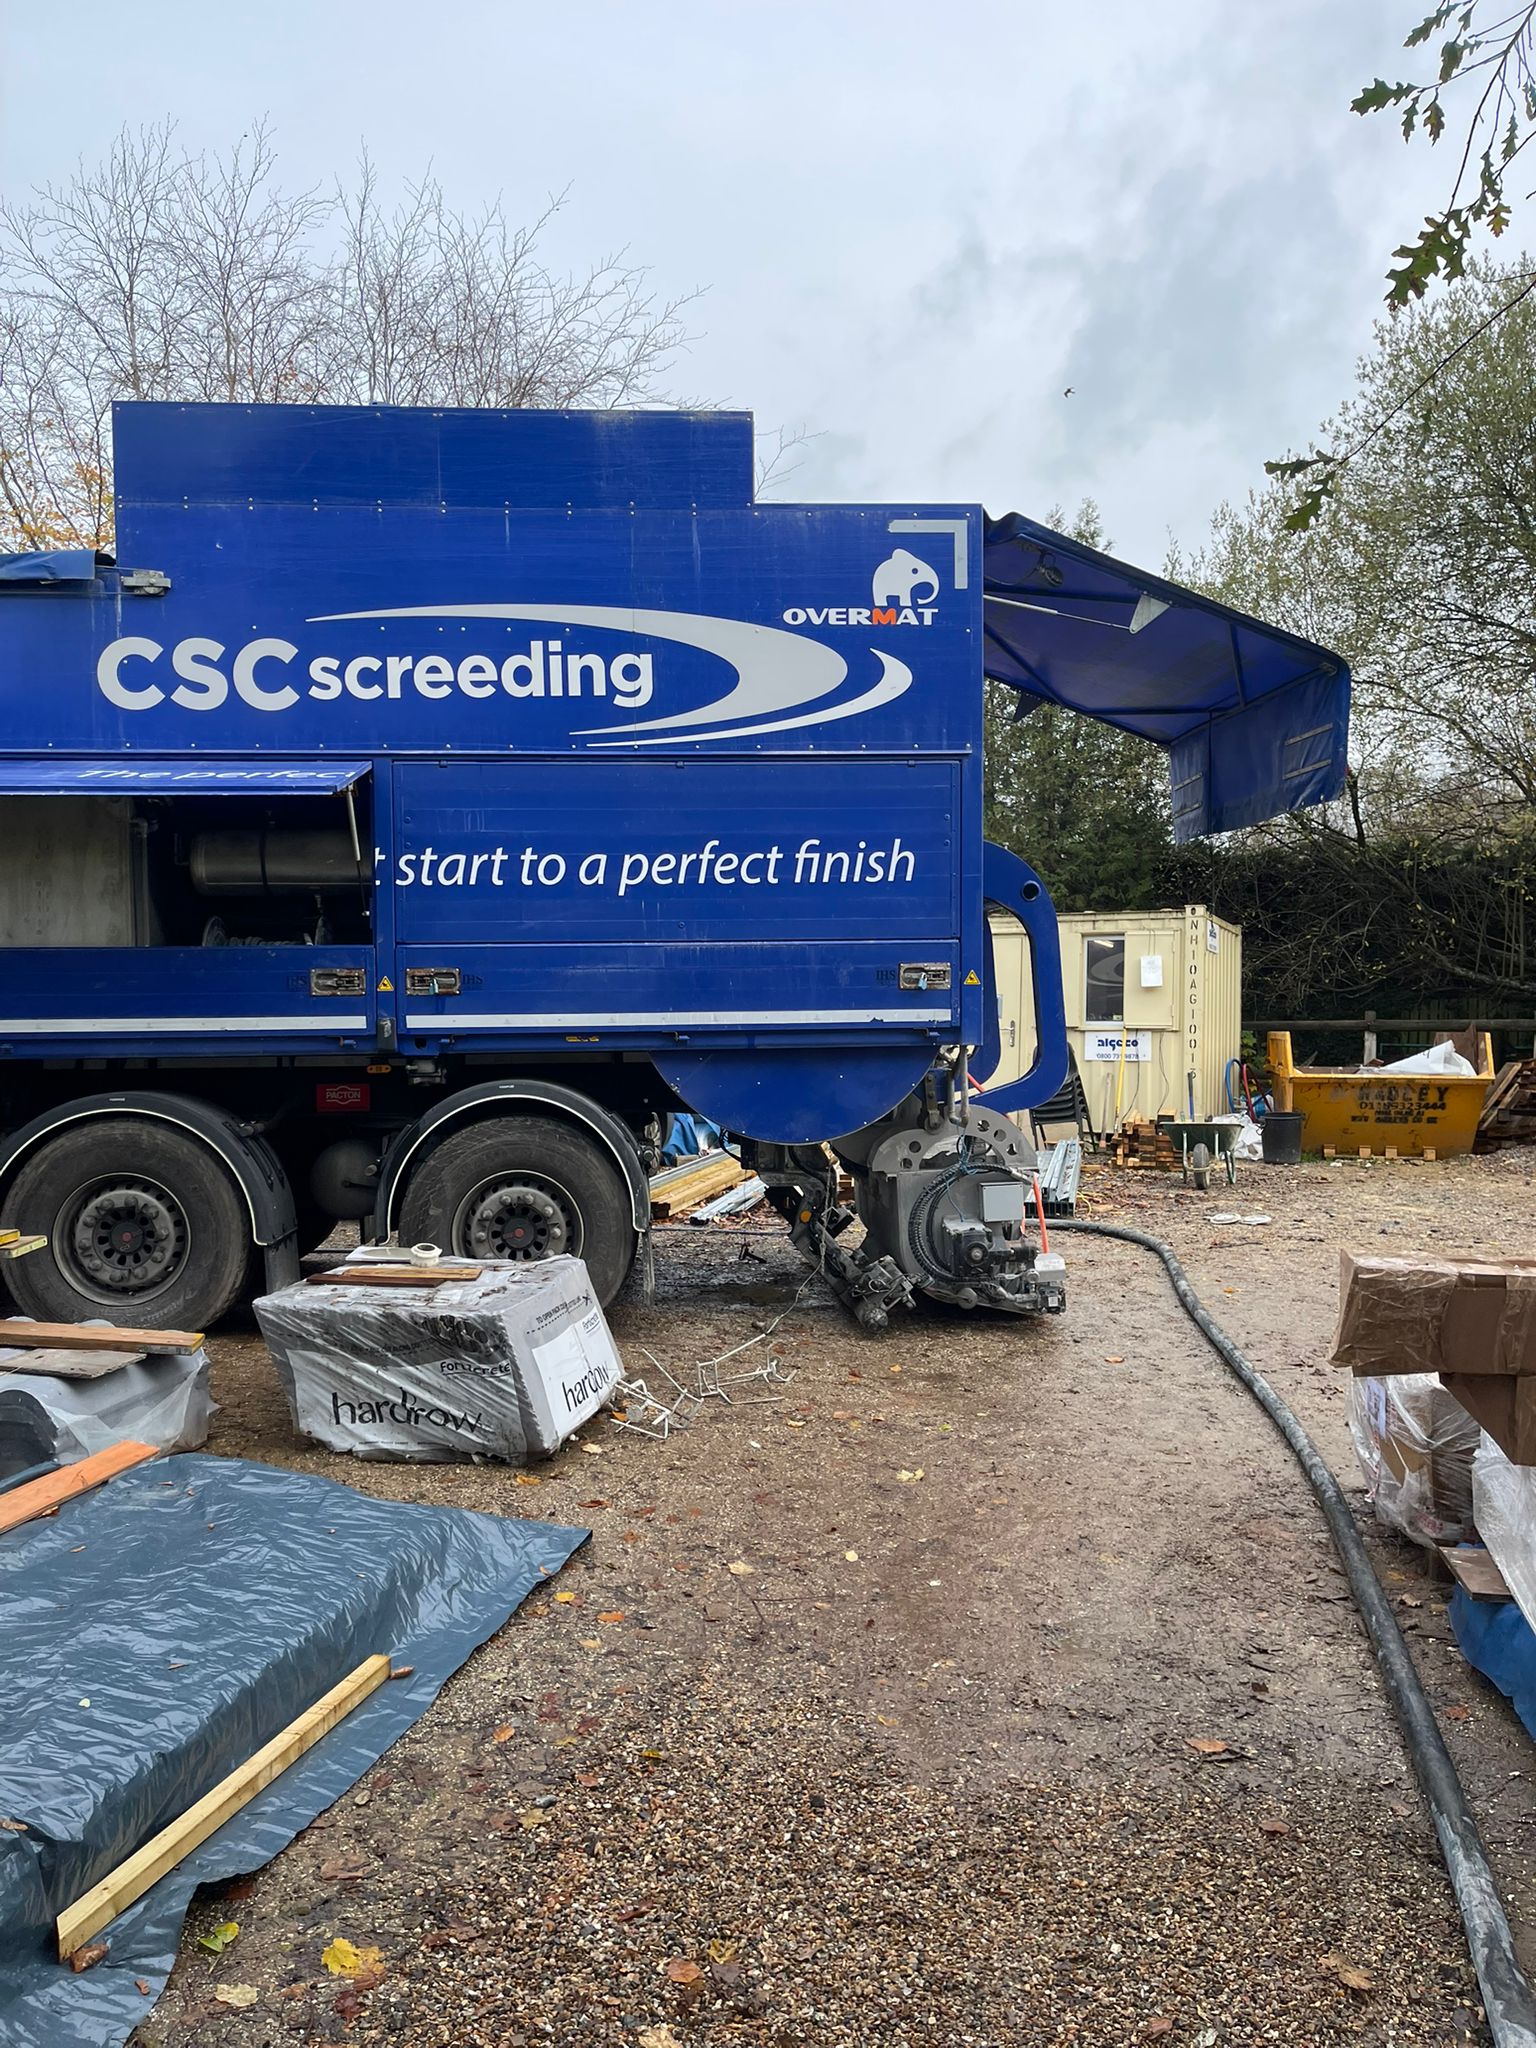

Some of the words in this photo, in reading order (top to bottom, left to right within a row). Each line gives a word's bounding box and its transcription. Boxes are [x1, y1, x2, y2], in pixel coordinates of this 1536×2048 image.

[782, 608, 939, 626] OVERMAT
[97, 636, 301, 712] CSC
[308, 640, 654, 708] screeding
[77, 769, 171, 779] The
[172, 769, 356, 781] perfec
[395, 847, 509, 887] start
[520, 847, 566, 887] to
[578, 853, 608, 886] a
[618, 840, 784, 896] perfect
[794, 838, 916, 884] finish
[331, 1388, 483, 1432] hardrow
